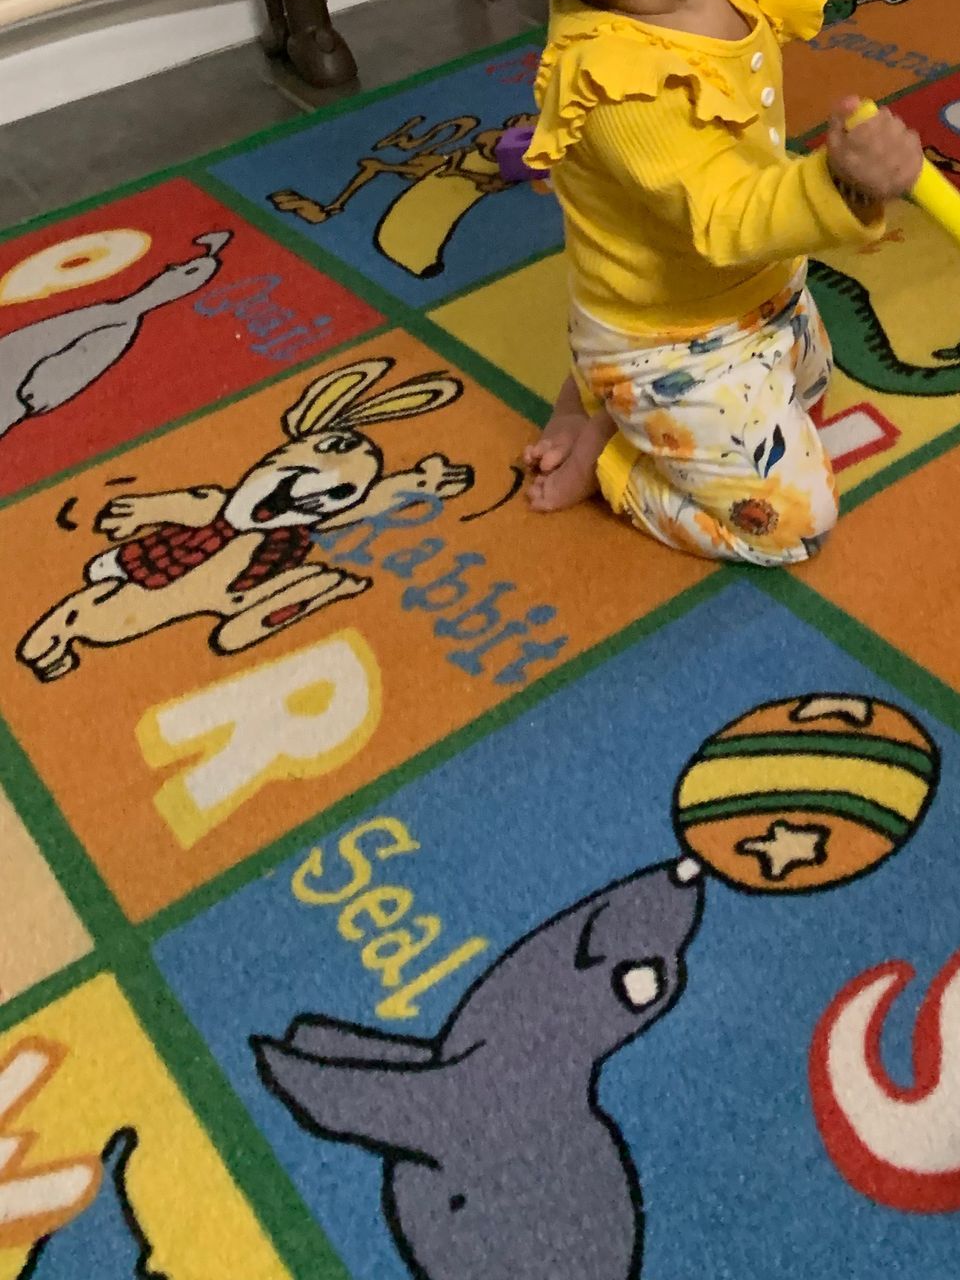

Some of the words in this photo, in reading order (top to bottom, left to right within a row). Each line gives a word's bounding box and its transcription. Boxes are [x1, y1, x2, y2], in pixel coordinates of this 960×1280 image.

[309, 489, 570, 685] Rabbit
[134, 627, 382, 851] R
[290, 816, 490, 1020] Seal
